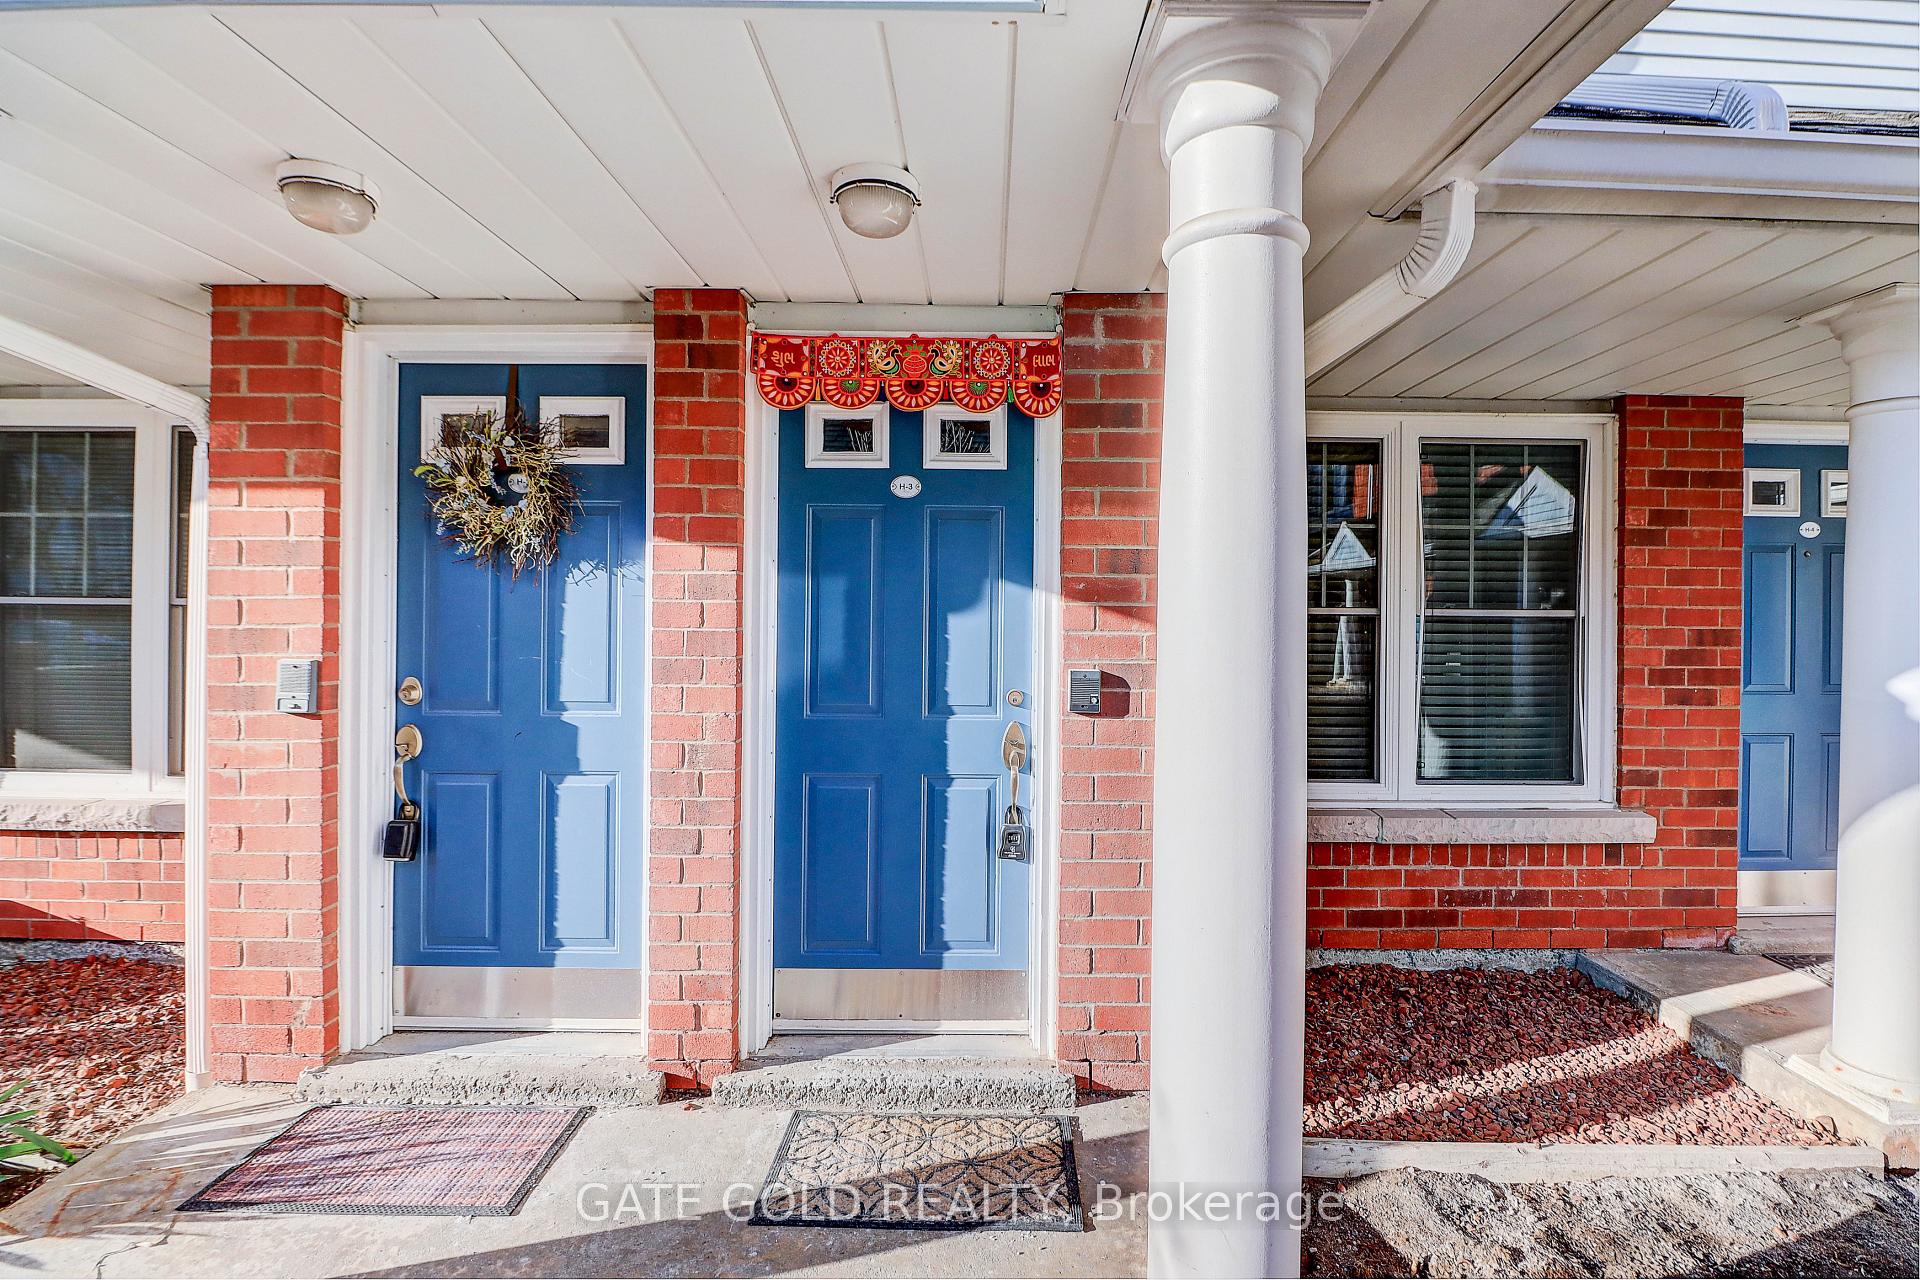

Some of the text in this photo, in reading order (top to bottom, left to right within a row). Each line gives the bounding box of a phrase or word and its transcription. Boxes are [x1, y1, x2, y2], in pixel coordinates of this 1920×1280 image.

[770, 350, 1056, 368] શુભ લાભ
[899, 482, 913, 490] H-3
